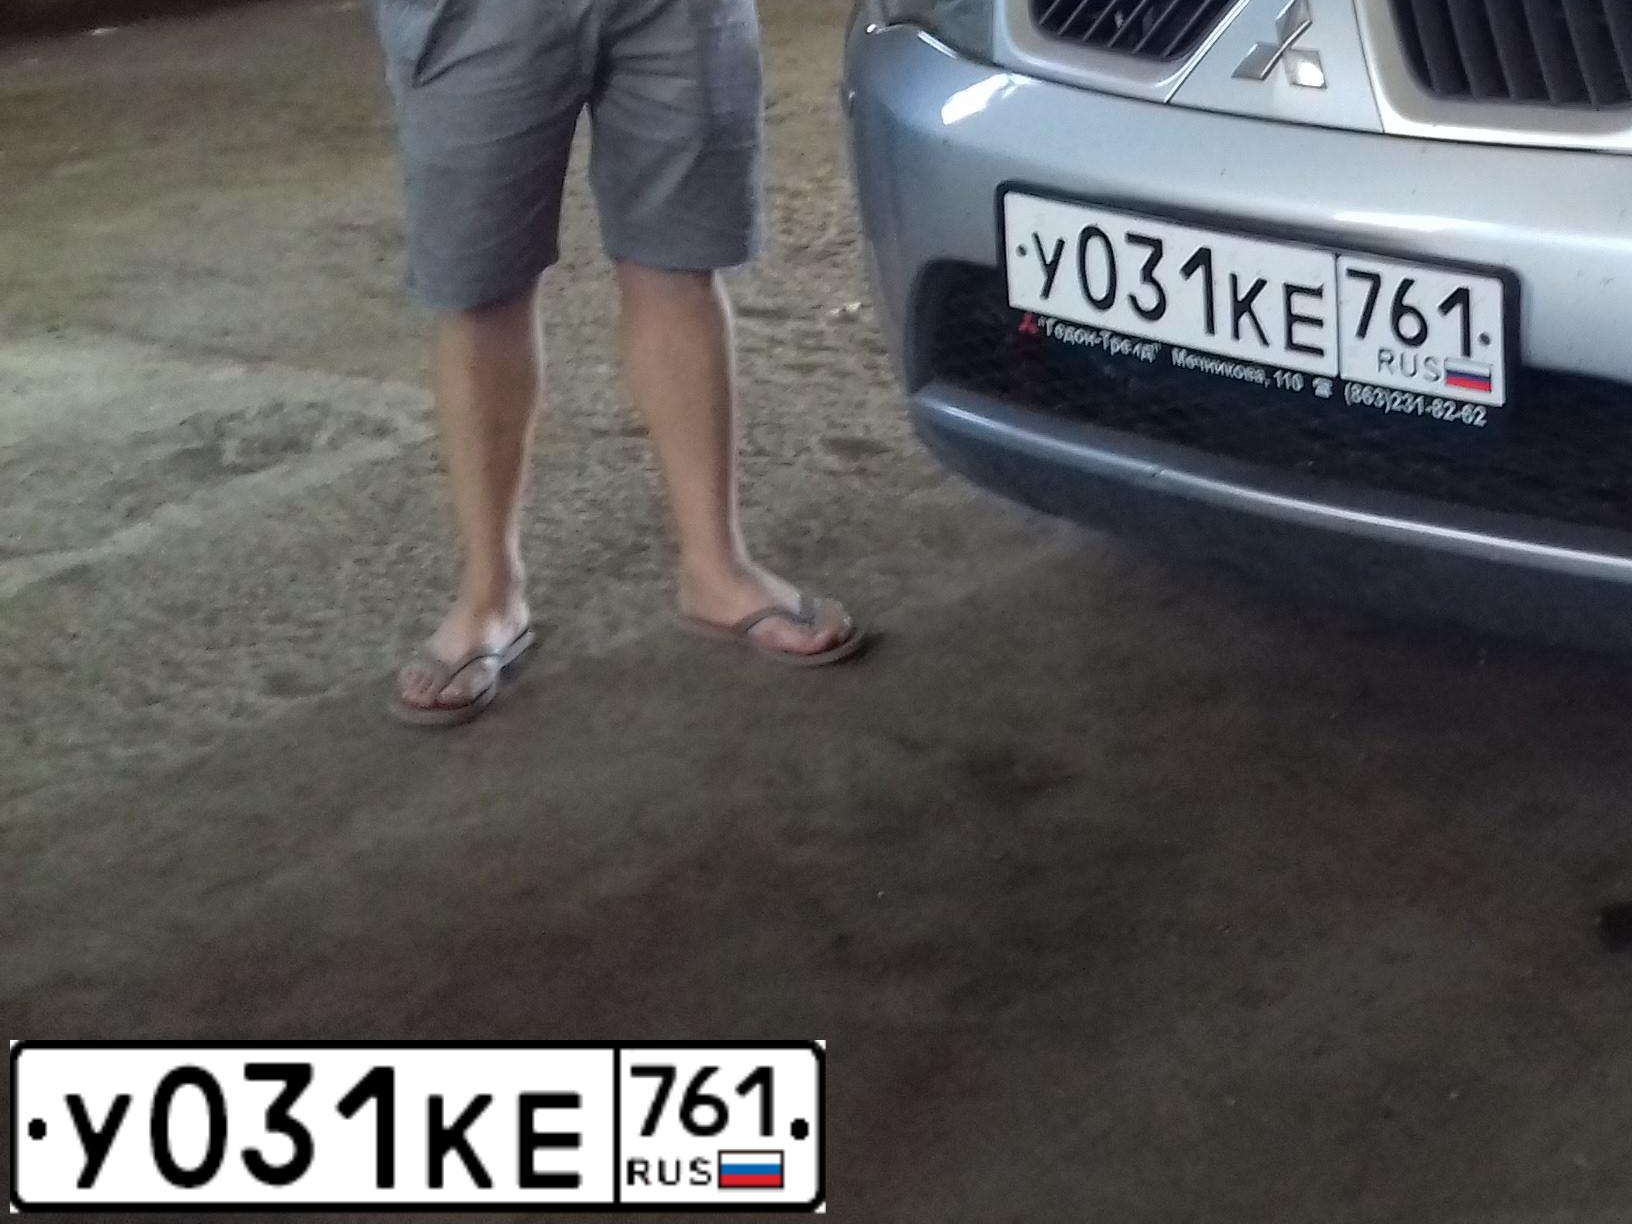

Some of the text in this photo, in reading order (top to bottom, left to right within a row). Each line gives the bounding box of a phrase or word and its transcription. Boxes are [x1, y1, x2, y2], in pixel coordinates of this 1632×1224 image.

[1345, 267, 1473, 359] 761
[1273, 369, 1305, 392] 110
[1378, 347, 1442, 383] RUS
